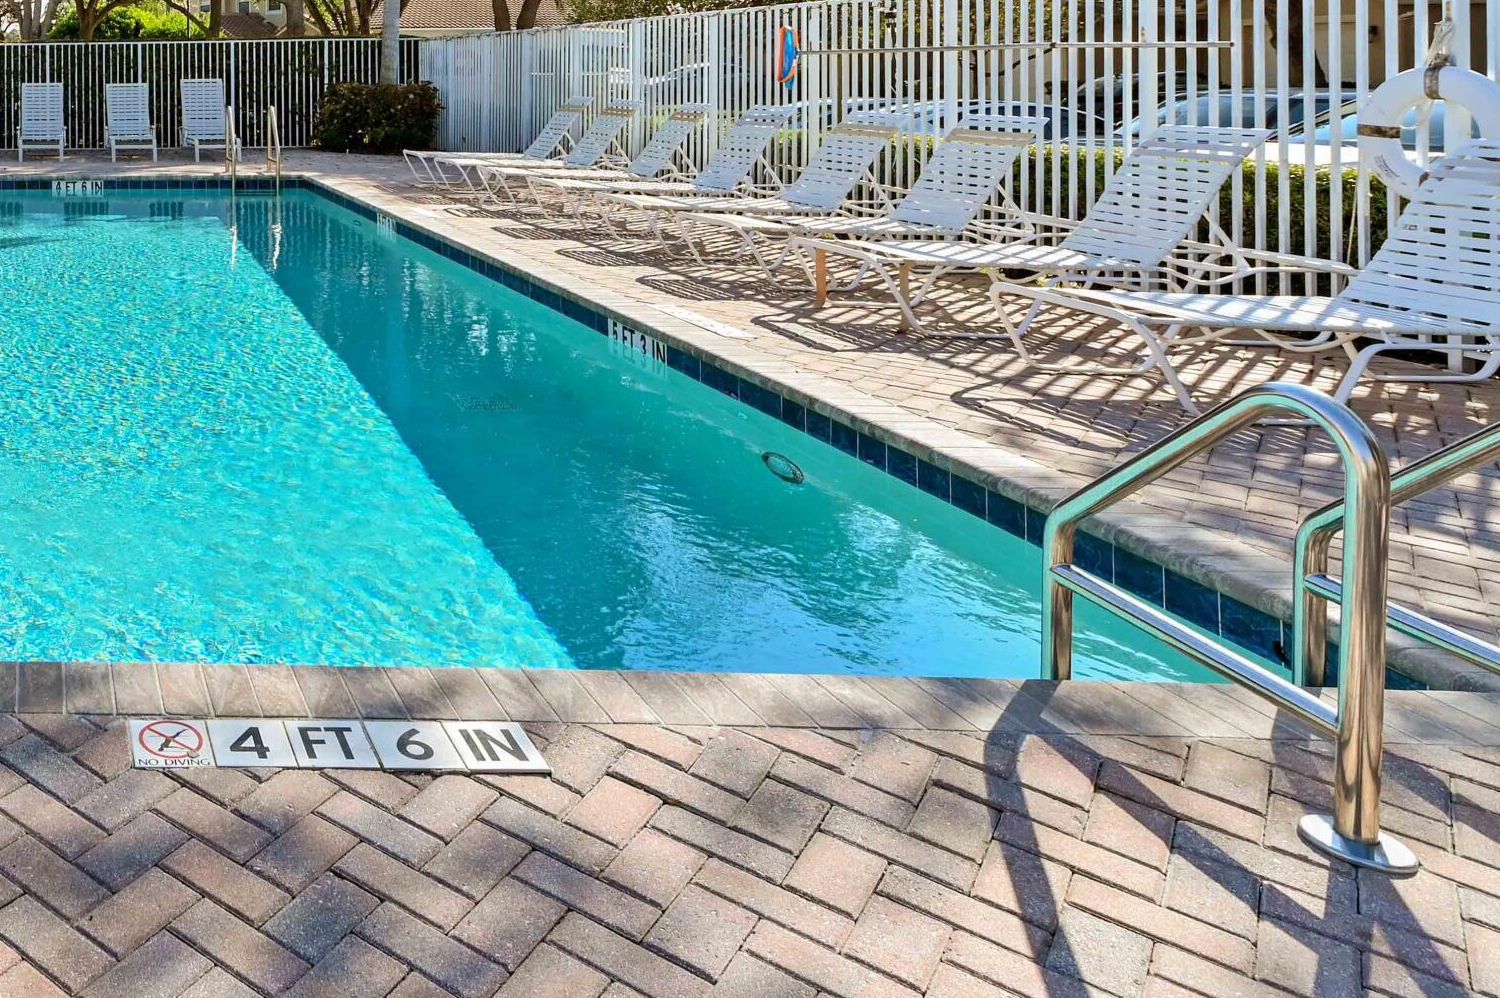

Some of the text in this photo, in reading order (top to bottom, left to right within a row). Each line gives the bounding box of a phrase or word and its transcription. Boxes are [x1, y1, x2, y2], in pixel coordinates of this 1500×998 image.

[622, 325, 635, 349] FT
[640, 334, 647, 355] 3
[651, 339, 666, 363] IN
[138, 758, 211, 766] NO DIVING
[229, 726, 530, 762] 4 FT 6 IN
